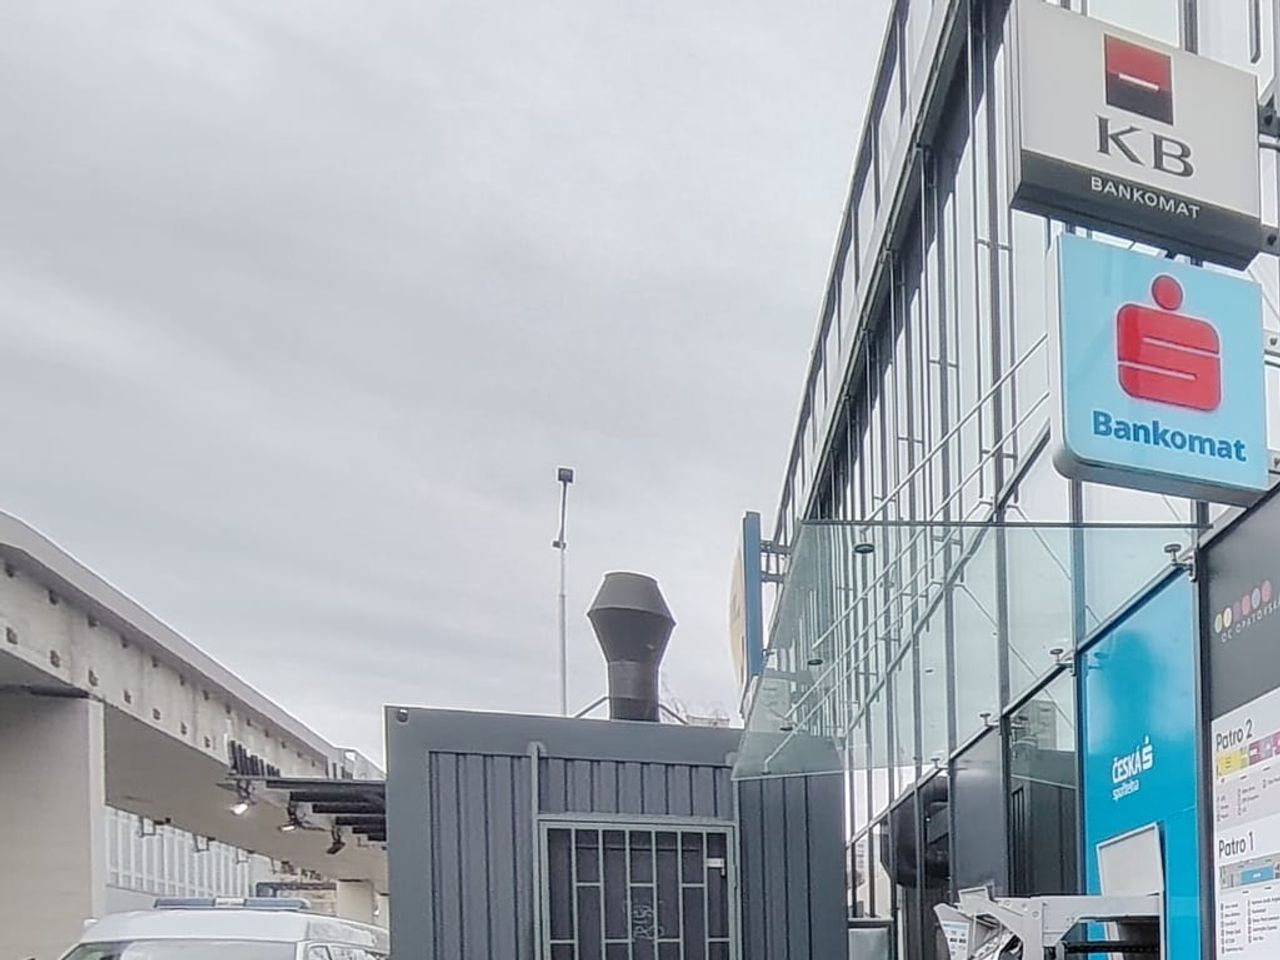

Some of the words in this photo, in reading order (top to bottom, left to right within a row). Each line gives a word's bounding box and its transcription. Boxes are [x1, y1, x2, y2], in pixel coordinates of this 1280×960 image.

[1095, 115, 1195, 179] KB
[1091, 175, 1200, 220] BANKOMAT
[1092, 408, 1247, 462] Bankomat
[1216, 727, 1244, 752] Patro
[1245, 719, 1253, 740] 2
[1112, 744, 1142, 785] ČESKÁ
[1218, 837, 1247, 858] Patro
[1248, 832, 1255, 852] 1
